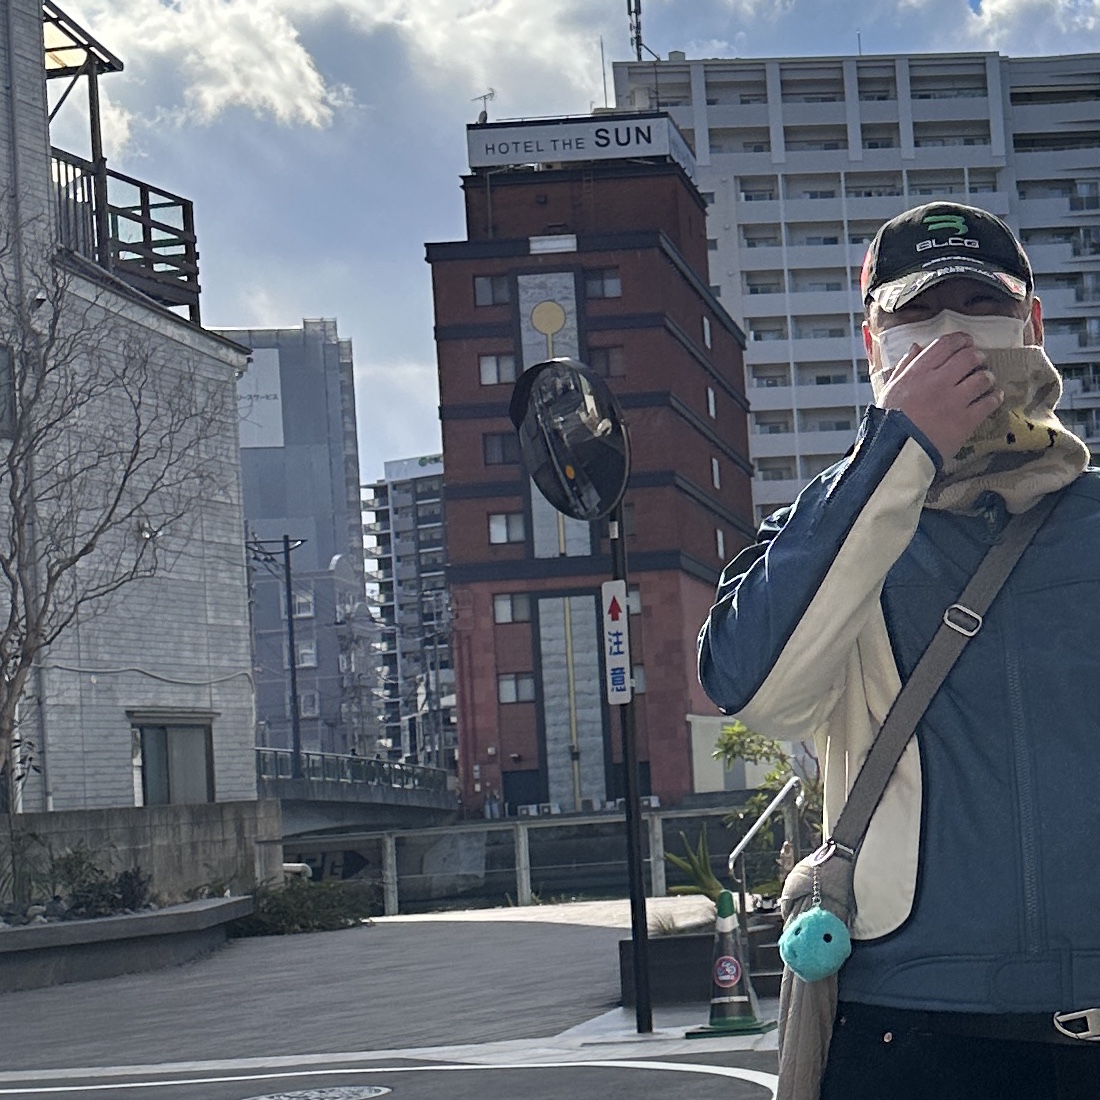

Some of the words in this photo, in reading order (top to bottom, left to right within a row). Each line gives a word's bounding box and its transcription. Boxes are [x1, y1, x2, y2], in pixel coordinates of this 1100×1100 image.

[485, 140, 544, 155] HOTEL
[550, 137, 585, 151] THE
[594, 125, 652, 148] SUN
[608, 630, 627, 693] 注意
